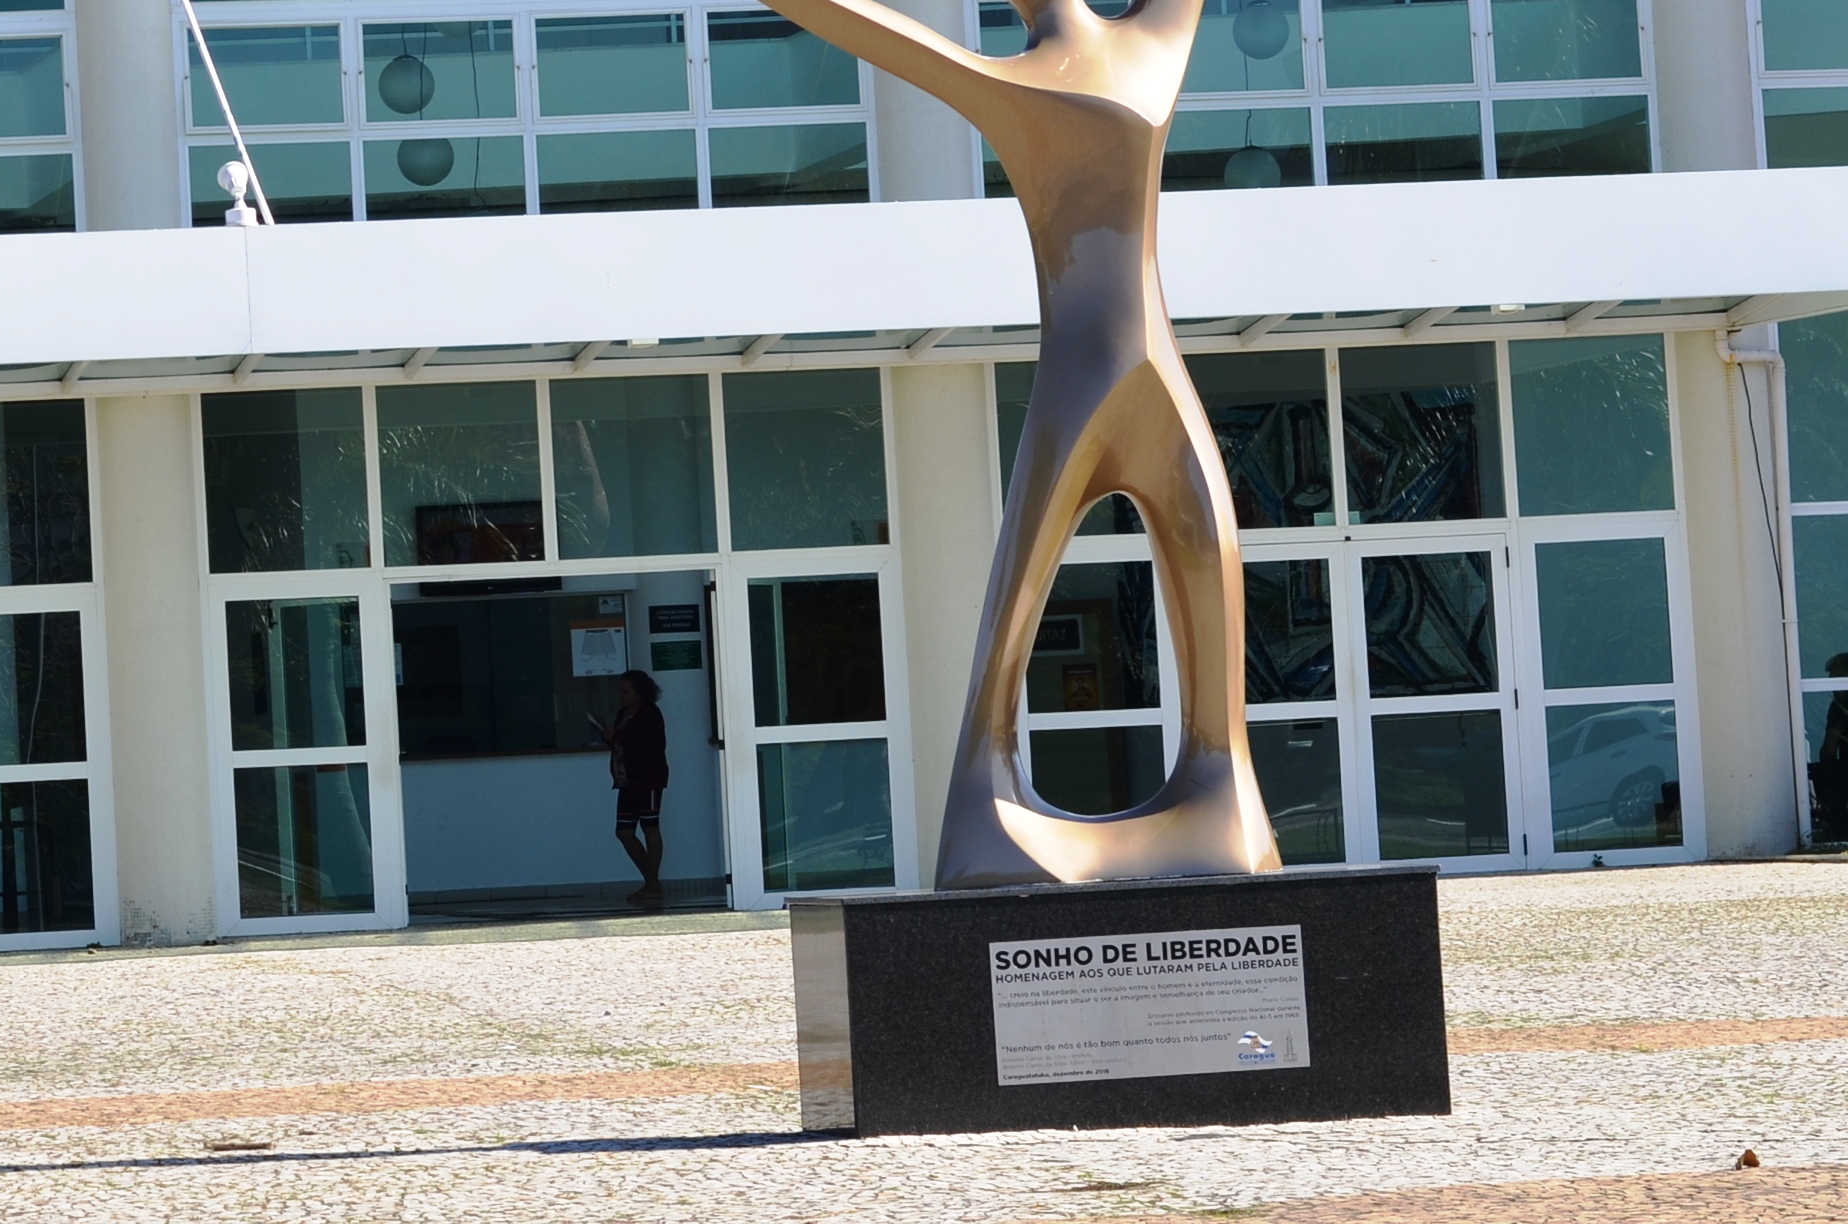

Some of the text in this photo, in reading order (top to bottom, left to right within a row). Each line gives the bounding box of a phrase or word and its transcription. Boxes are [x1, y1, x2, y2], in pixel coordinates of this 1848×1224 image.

[995, 934, 1297, 970] SONHO DE LIBERDADE
[995, 957, 1299, 984] HOMENAGEM AOS QUE LUTARAM PELA LIBERDADE
[1009, 991, 1029, 999] creio
[1041, 988, 1080, 997] liberdade,
[1157, 981, 1186, 990] homem
[1201, 978, 1244, 987] eternidade,
[1263, 975, 1298, 984] condição
[998, 999, 1050, 1009] indispensável
[1051, 998, 1068, 1007] para
[1069, 997, 1091, 1005] situar
[1120, 993, 1151, 1003] imagem
[1159, 990, 1203, 999] semelhança
[1215, 1008, 1247, 1017] Congresso
[1002, 1044, 1042, 1053] "Nenhum
[1044, 1043, 1056, 1051] de
[1058, 1042, 1074, 1050] nós
[1083, 1040, 1099, 1048] tão
[1100, 1039, 1121, 1047] bom
[1122, 1037, 1153, 1047] quanto
[1156, 1036, 1181, 1044] todos
[1183, 1034, 1199, 1042] nós
[1200, 1032, 1232, 1043] juntos"
